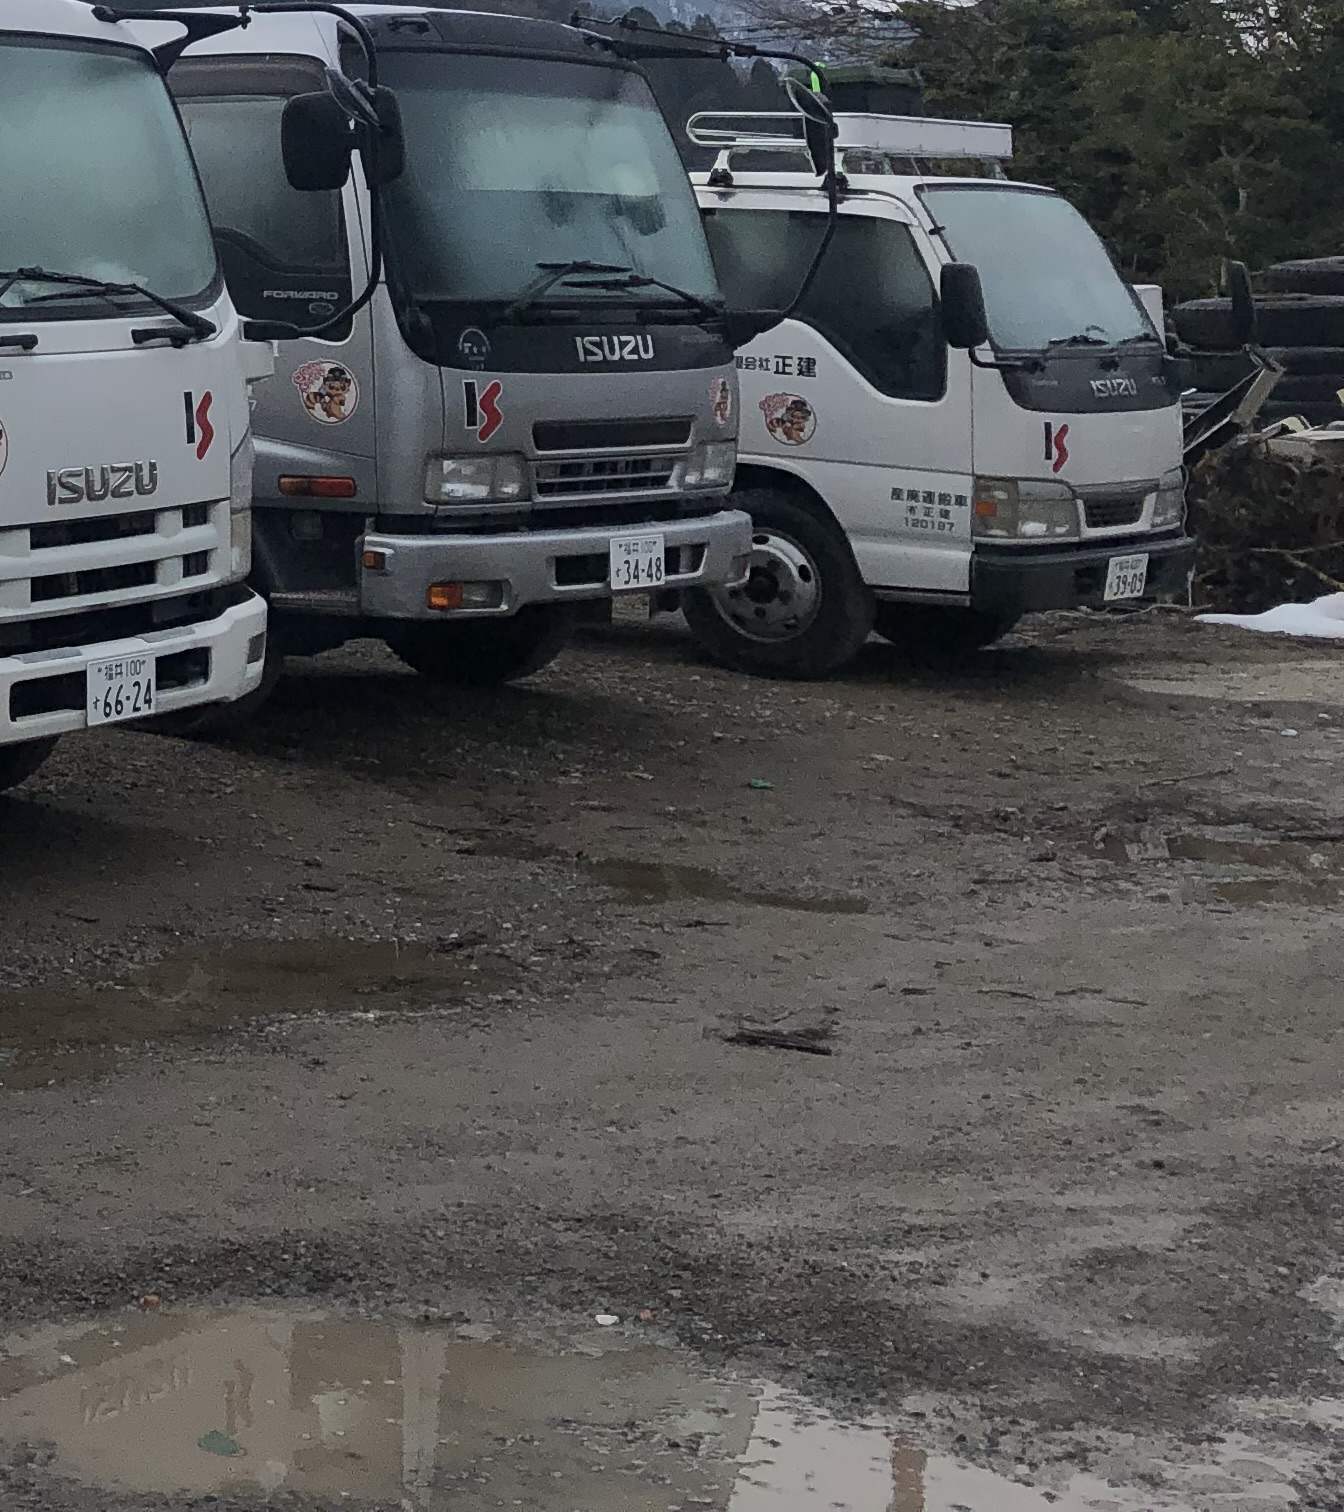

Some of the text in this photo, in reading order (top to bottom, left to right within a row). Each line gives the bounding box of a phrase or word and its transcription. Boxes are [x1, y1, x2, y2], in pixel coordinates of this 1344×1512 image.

[263, 290, 339, 300] FORWARD
[575, 334, 655, 363] ISUZU
[1089, 378, 1138, 399] ISUZU
[46, 459, 159, 506] ISUZU
[903, 517, 955, 532] 120197
[623, 556, 662, 586] 34-48
[125, 658, 142, 678] 100
[102, 677, 153, 719] 66-24
